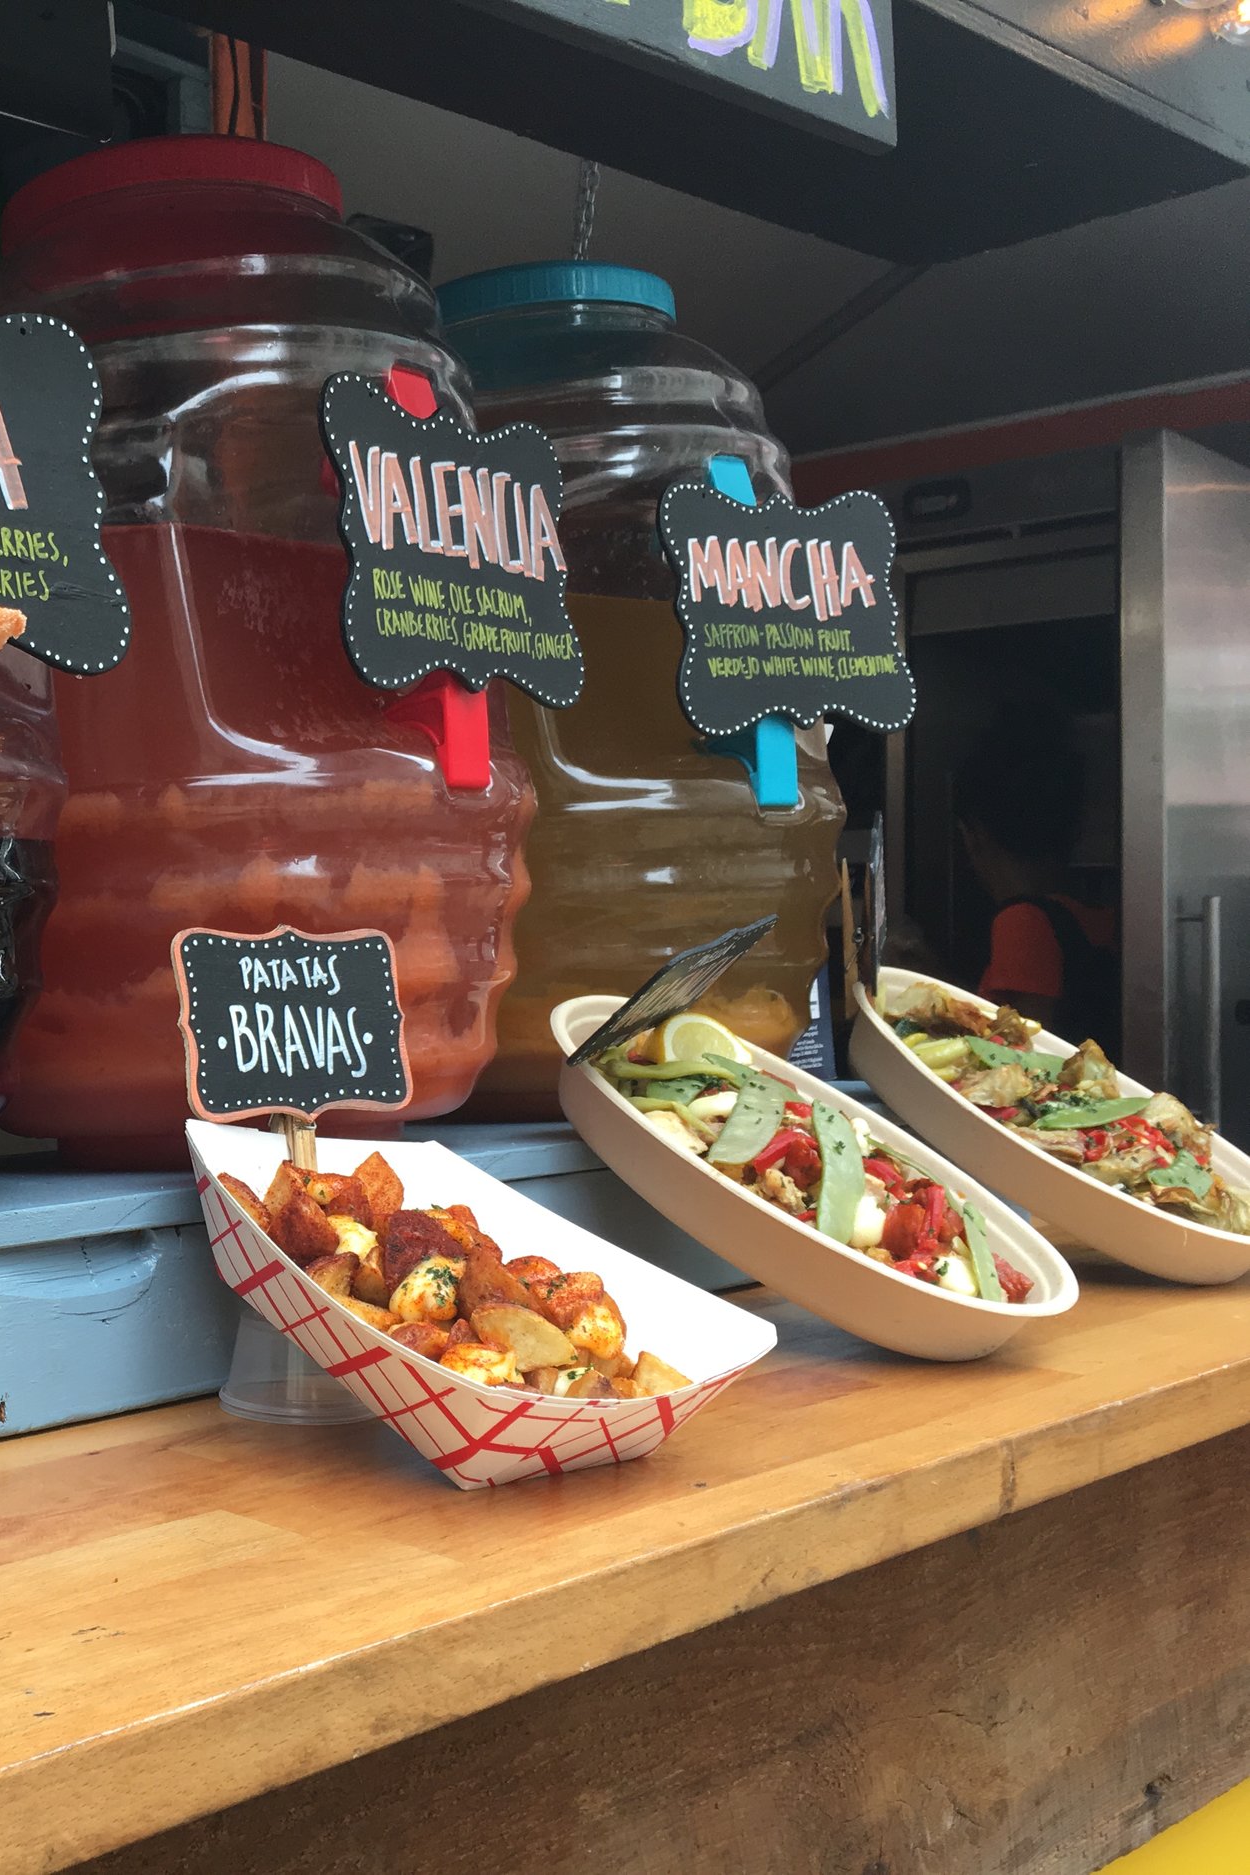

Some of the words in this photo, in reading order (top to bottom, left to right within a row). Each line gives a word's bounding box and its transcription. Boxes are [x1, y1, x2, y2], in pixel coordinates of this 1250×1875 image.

[348, 440, 568, 583] VALENCIA
[372, 568, 406, 600] ROSE
[687, 535, 877, 622] MANCHA
[375, 607, 463, 648] CRANBERRIES,
[534, 632, 576, 661] GINGER
[816, 628, 855, 653] FRUIT,
[707, 655, 760, 680] VERDEJO
[762, 655, 801, 677] WHITE
[837, 653, 899, 680] CLEMENTINE
[238, 954, 341, 996] PATATAS
[228, 1002, 368, 1078] BRAVAS
